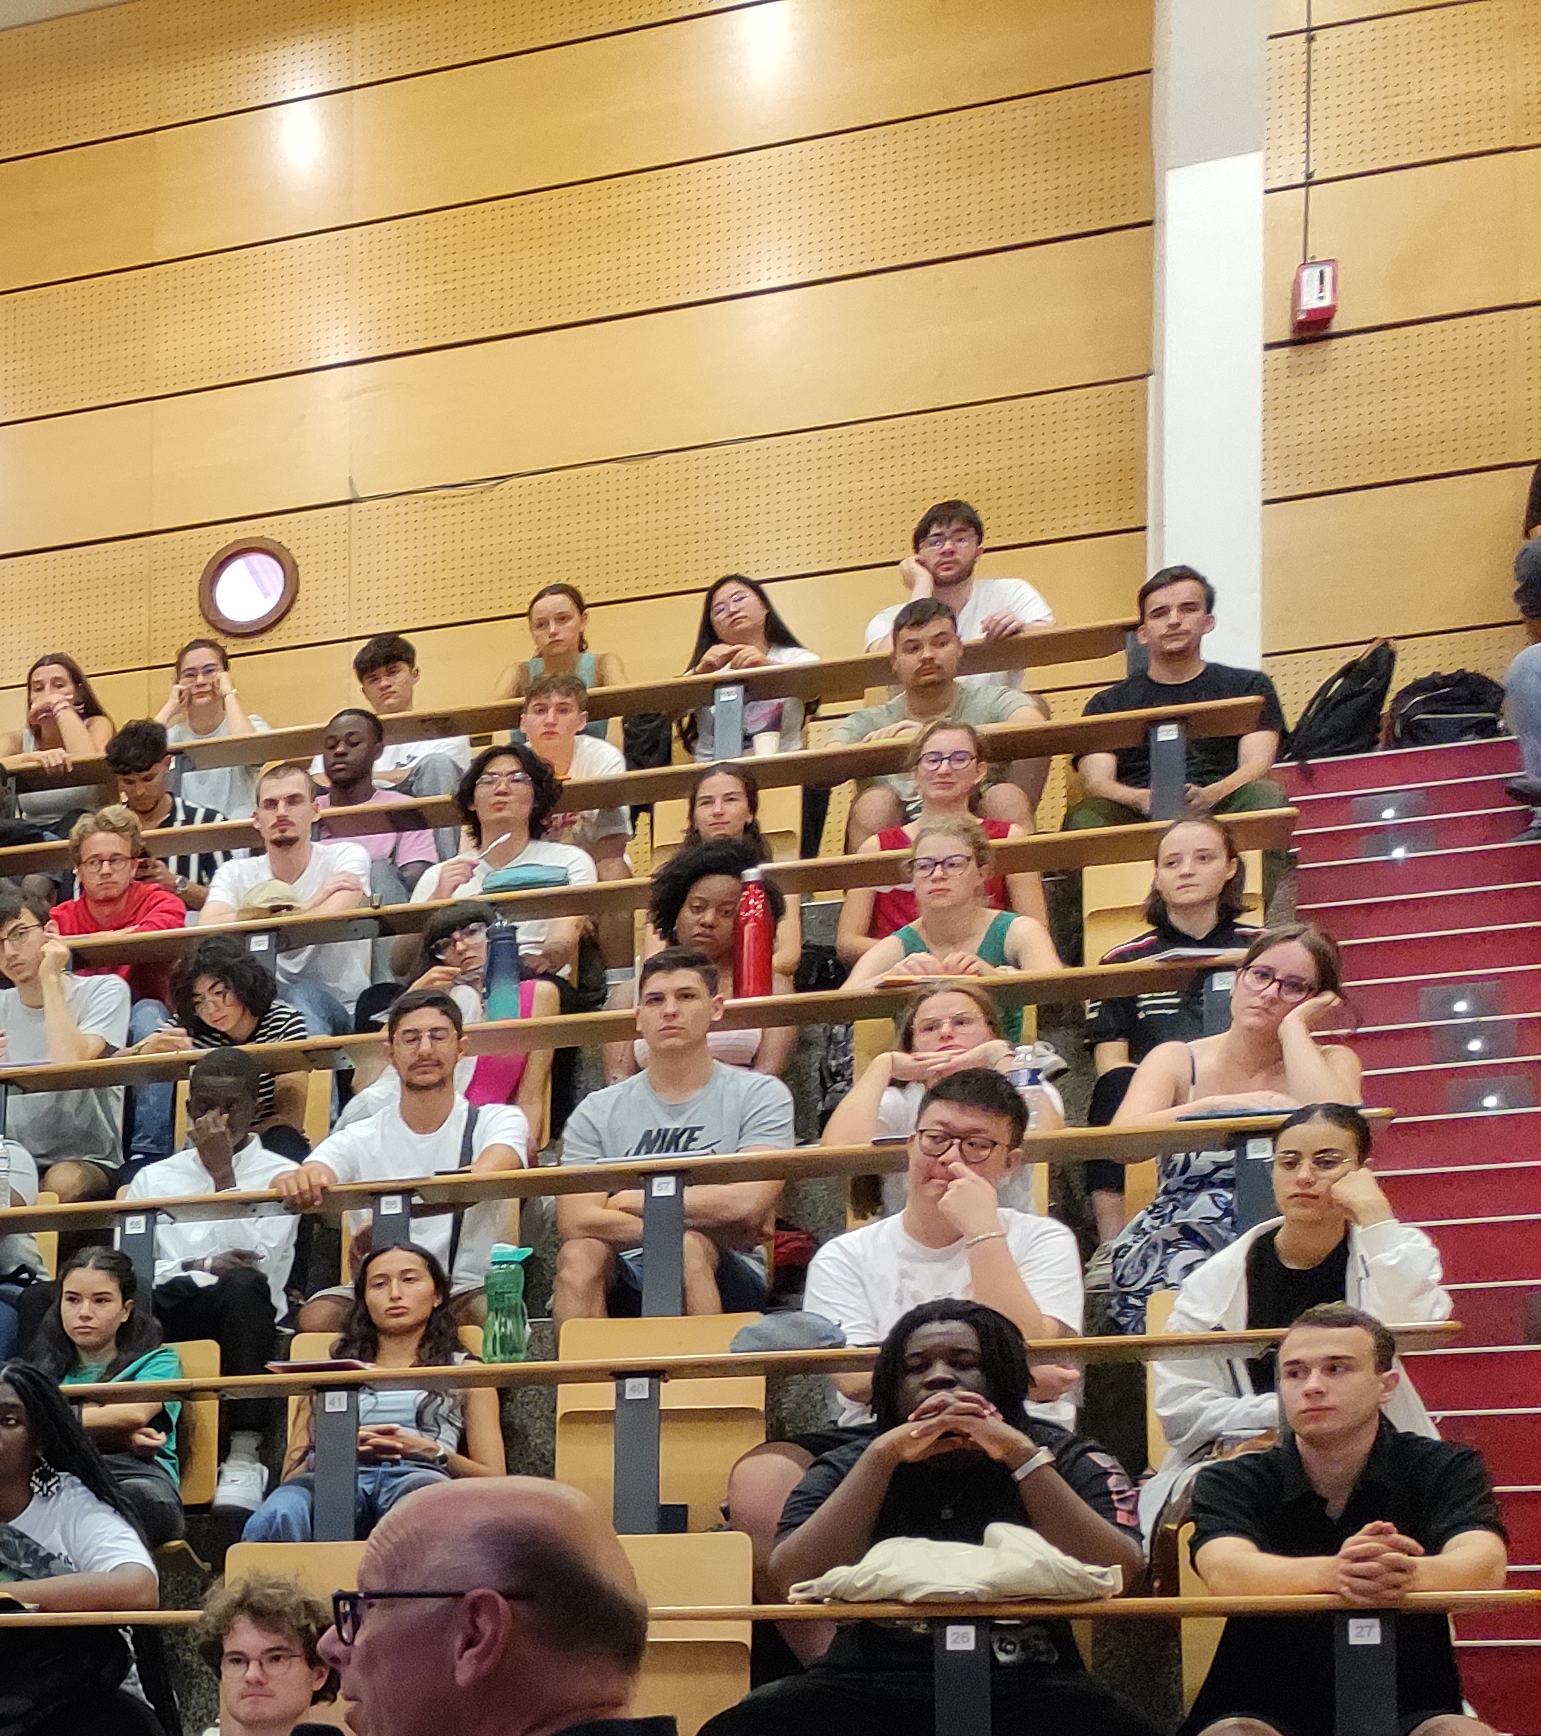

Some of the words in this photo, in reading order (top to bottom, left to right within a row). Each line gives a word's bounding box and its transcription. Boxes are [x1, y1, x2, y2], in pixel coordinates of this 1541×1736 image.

[630, 1126, 705, 1156] NIKE
[328, 1396, 342, 1407] 41
[1354, 1625, 1375, 1638] 27
